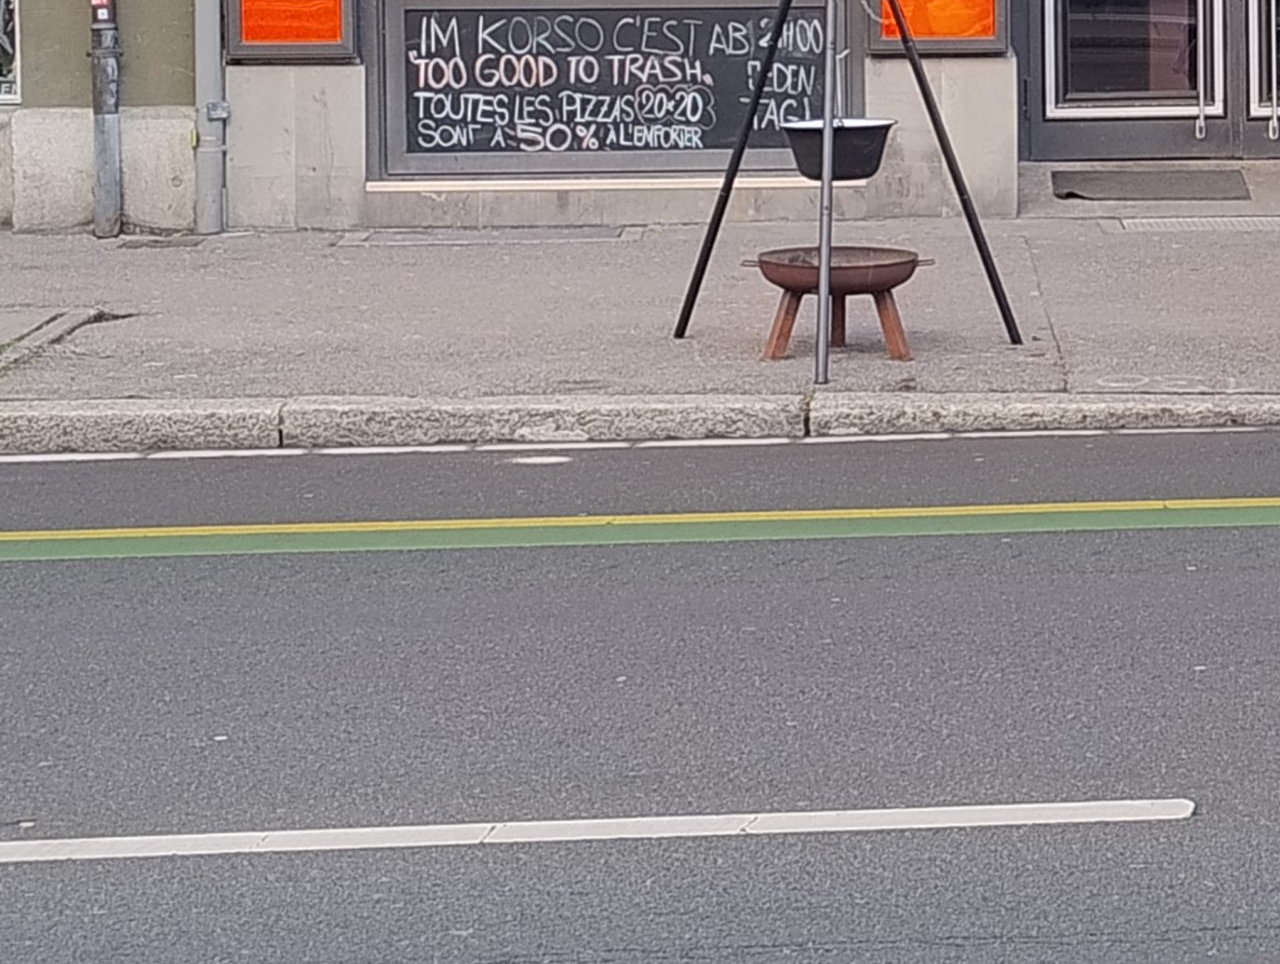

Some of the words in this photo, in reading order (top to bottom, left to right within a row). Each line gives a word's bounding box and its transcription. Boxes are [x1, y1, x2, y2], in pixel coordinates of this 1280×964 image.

[420, 16, 461, 56] IM
[478, 15, 604, 54] KORSO
[613, 15, 703, 57] C'EST
[709, 21, 750, 56] AB
[758, 18, 824, 54] 2H00
[475, 53, 558, 87] GOOD
[567, 55, 600, 84] TO
[413, 92, 509, 125] TOUTES
[514, 94, 553, 126] LES
[558, 90, 635, 122] PIZZAS
[418, 119, 482, 148] SONT
[619, 123, 704, 148] L'EMPORTER
